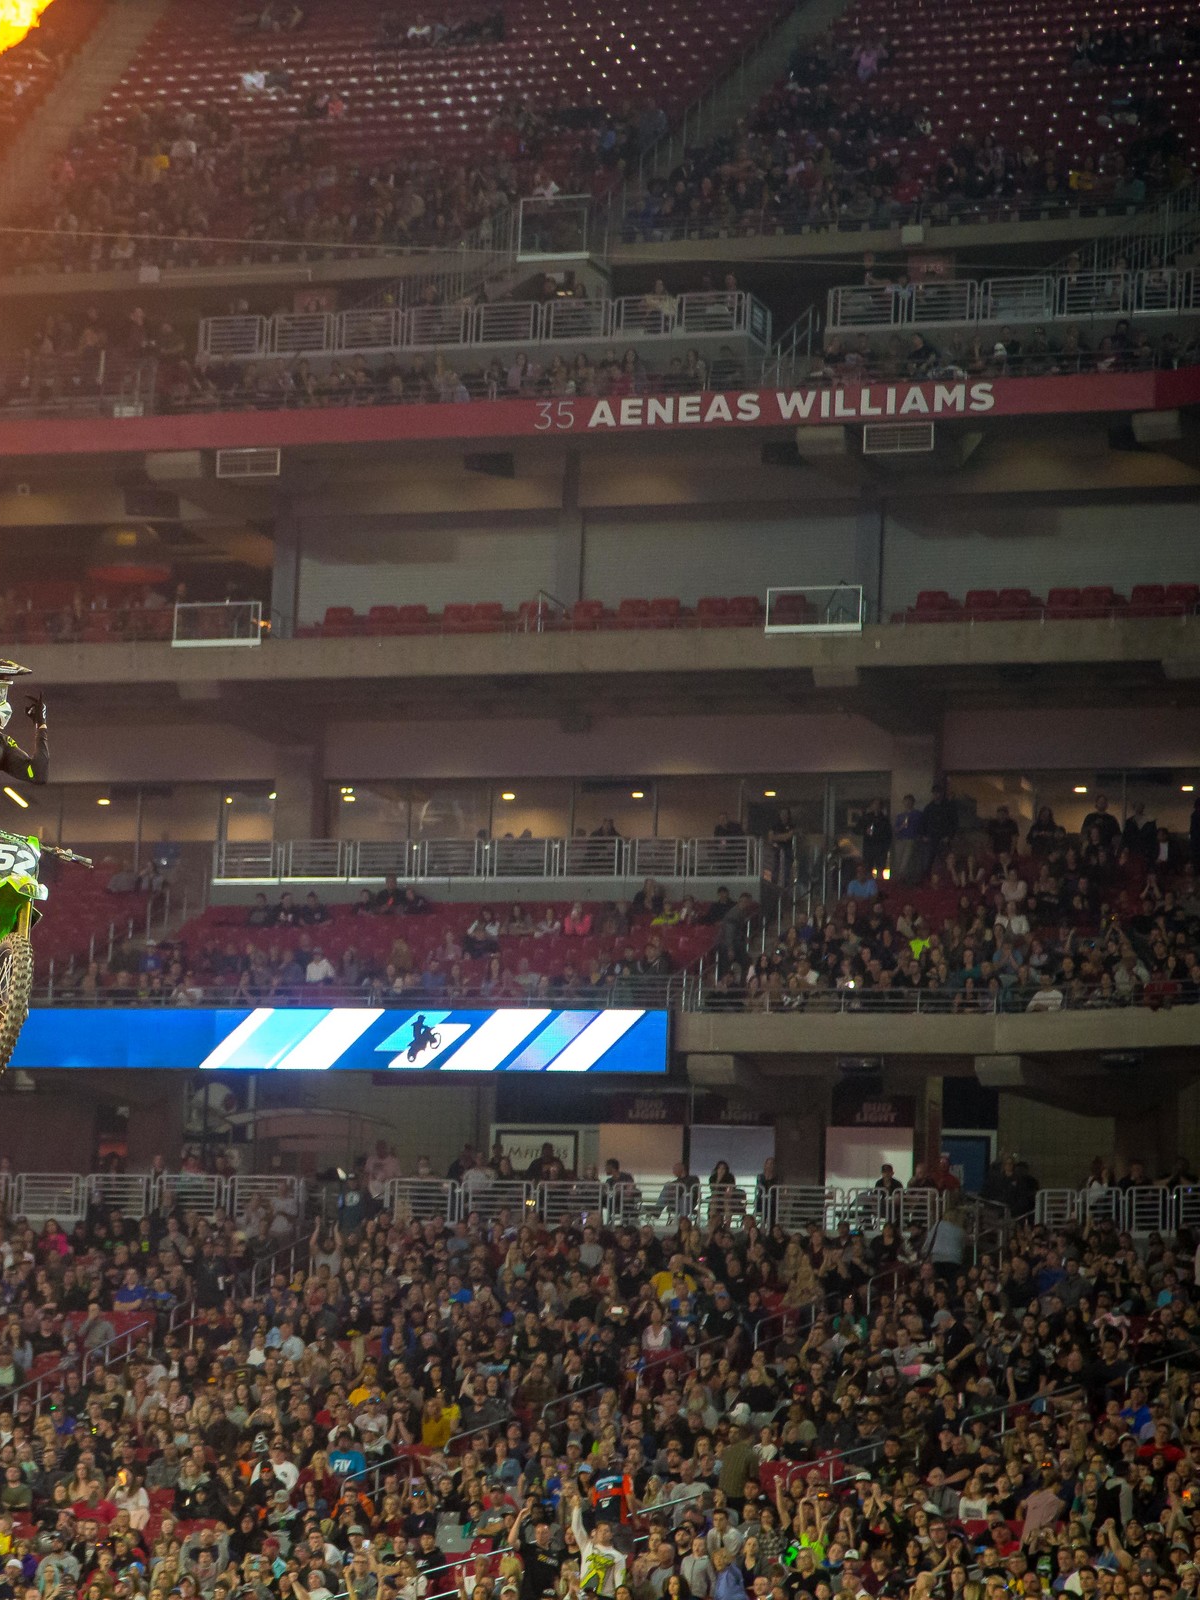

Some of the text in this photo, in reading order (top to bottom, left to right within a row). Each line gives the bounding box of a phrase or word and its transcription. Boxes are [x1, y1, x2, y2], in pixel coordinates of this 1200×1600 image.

[533, 383, 996, 430] 35 AENEAS WILLIAMS
[856, 1112, 897, 1123] LIGHT
